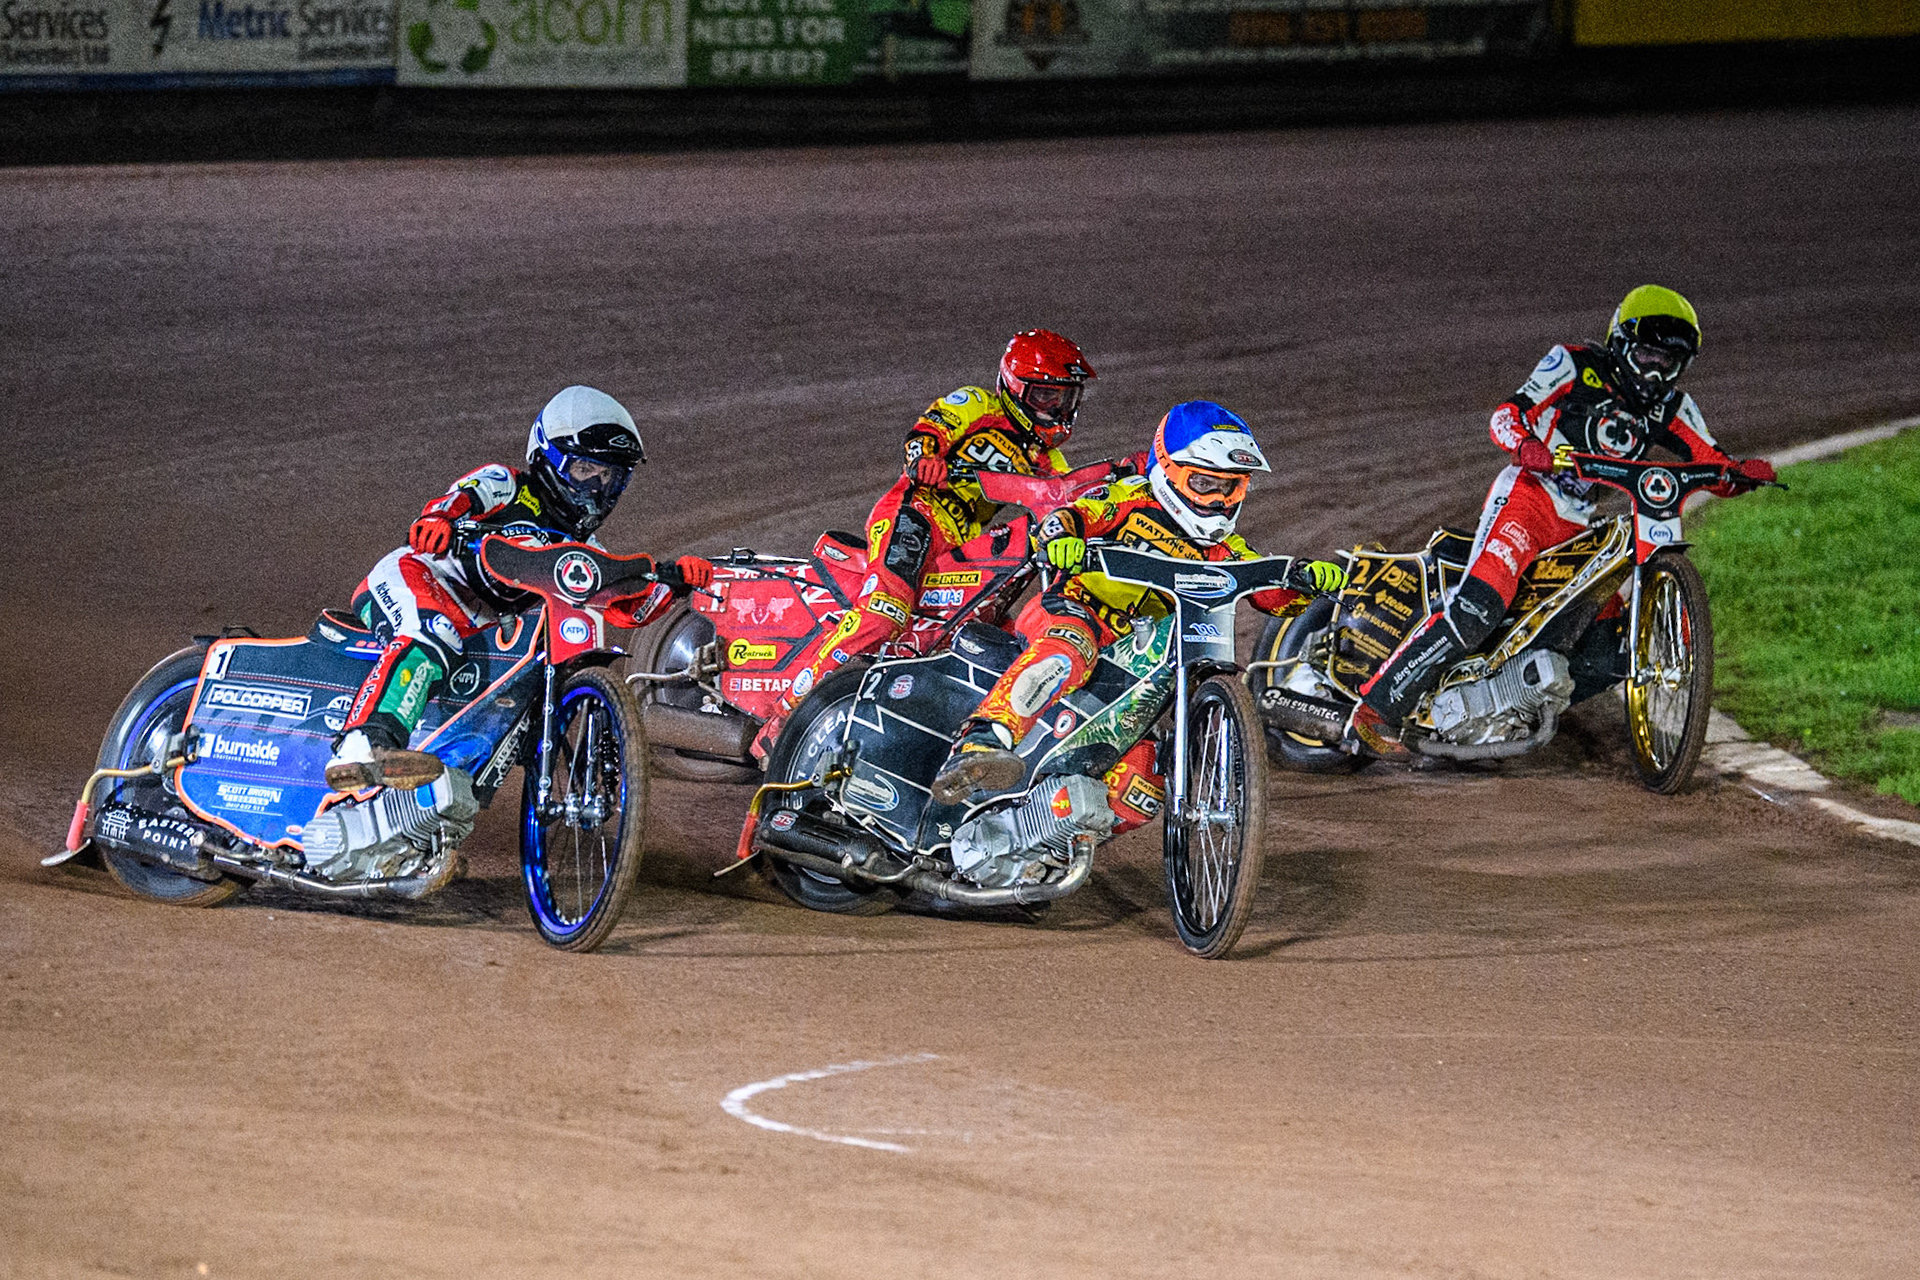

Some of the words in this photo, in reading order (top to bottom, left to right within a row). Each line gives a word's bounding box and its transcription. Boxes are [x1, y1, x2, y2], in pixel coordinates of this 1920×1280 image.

[2, 2, 108, 40] Services
[199, 1, 291, 40] Metric
[510, 0, 673, 44] acorn
[693, 17, 776, 43] NEED
[783, 17, 846, 43] FOR
[1135, 517, 1185, 553] WATLING
[1351, 559, 1371, 584] 2
[375, 581, 399, 611] Richard
[710, 582, 723, 612] 1
[1384, 595, 1413, 617] team
[870, 599, 908, 623] JCB
[564, 626, 585, 635] ATPI
[733, 644, 774, 660] Rentruck
[1048, 627, 1093, 661] JCB
[215, 650, 228, 675] 1
[1393, 667, 1412, 685] Jörg
[1408, 635, 1448, 669] Grohmann
[396, 659, 432, 719] MOTOREX
[862, 672, 883, 699] 2
[212, 689, 304, 714] POLCOPPER
[1276, 696, 1291, 707] SH
[214, 734, 280, 761] burnside
[216, 784, 248, 796] SCOTT
[247, 787, 282, 803] BROWN
[138, 817, 198, 840] EASTER
[142, 829, 188, 851] POINT
